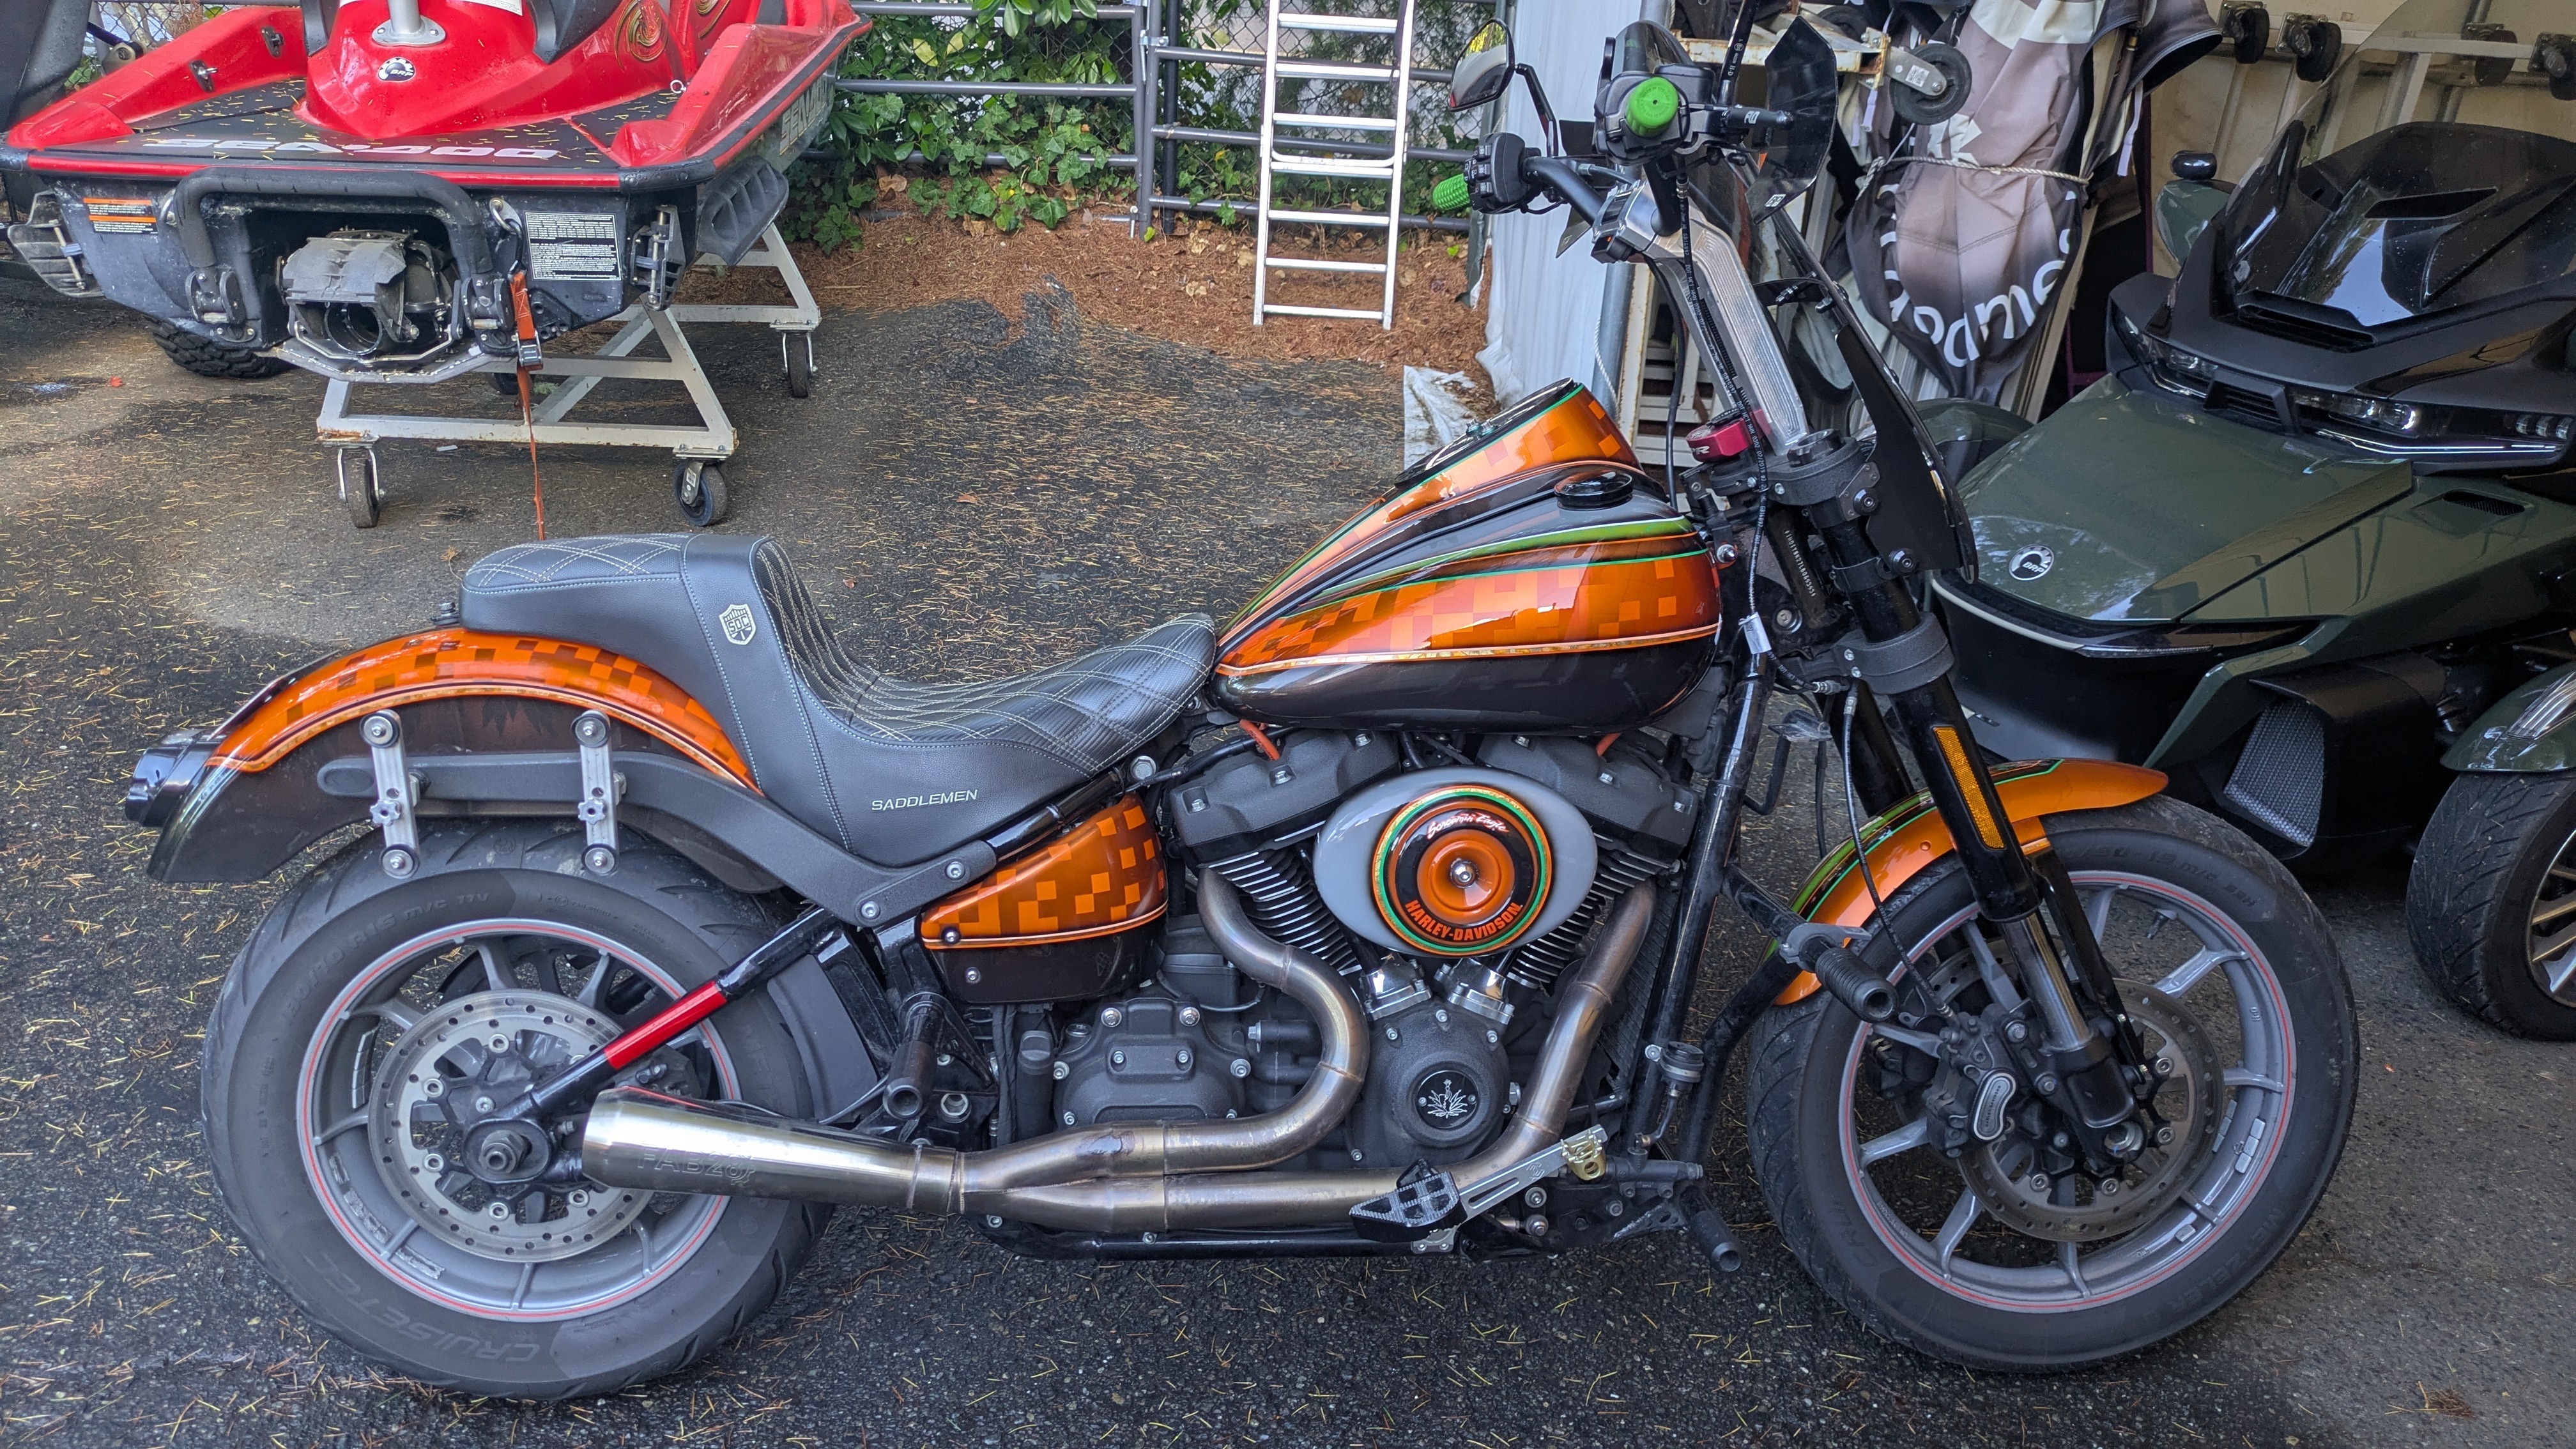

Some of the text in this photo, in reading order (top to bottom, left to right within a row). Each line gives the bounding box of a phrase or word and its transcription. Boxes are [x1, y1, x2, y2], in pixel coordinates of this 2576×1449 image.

[1735, 400, 1745, 411] DOT
[2022, 562, 2045, 572] BRP
[727, 615, 749, 632] SDC
[871, 789, 978, 811] SADDLEMEN
[1475, 811, 1510, 833] Eagle
[1405, 900, 1522, 941] HARLEY-DAVIDSON
